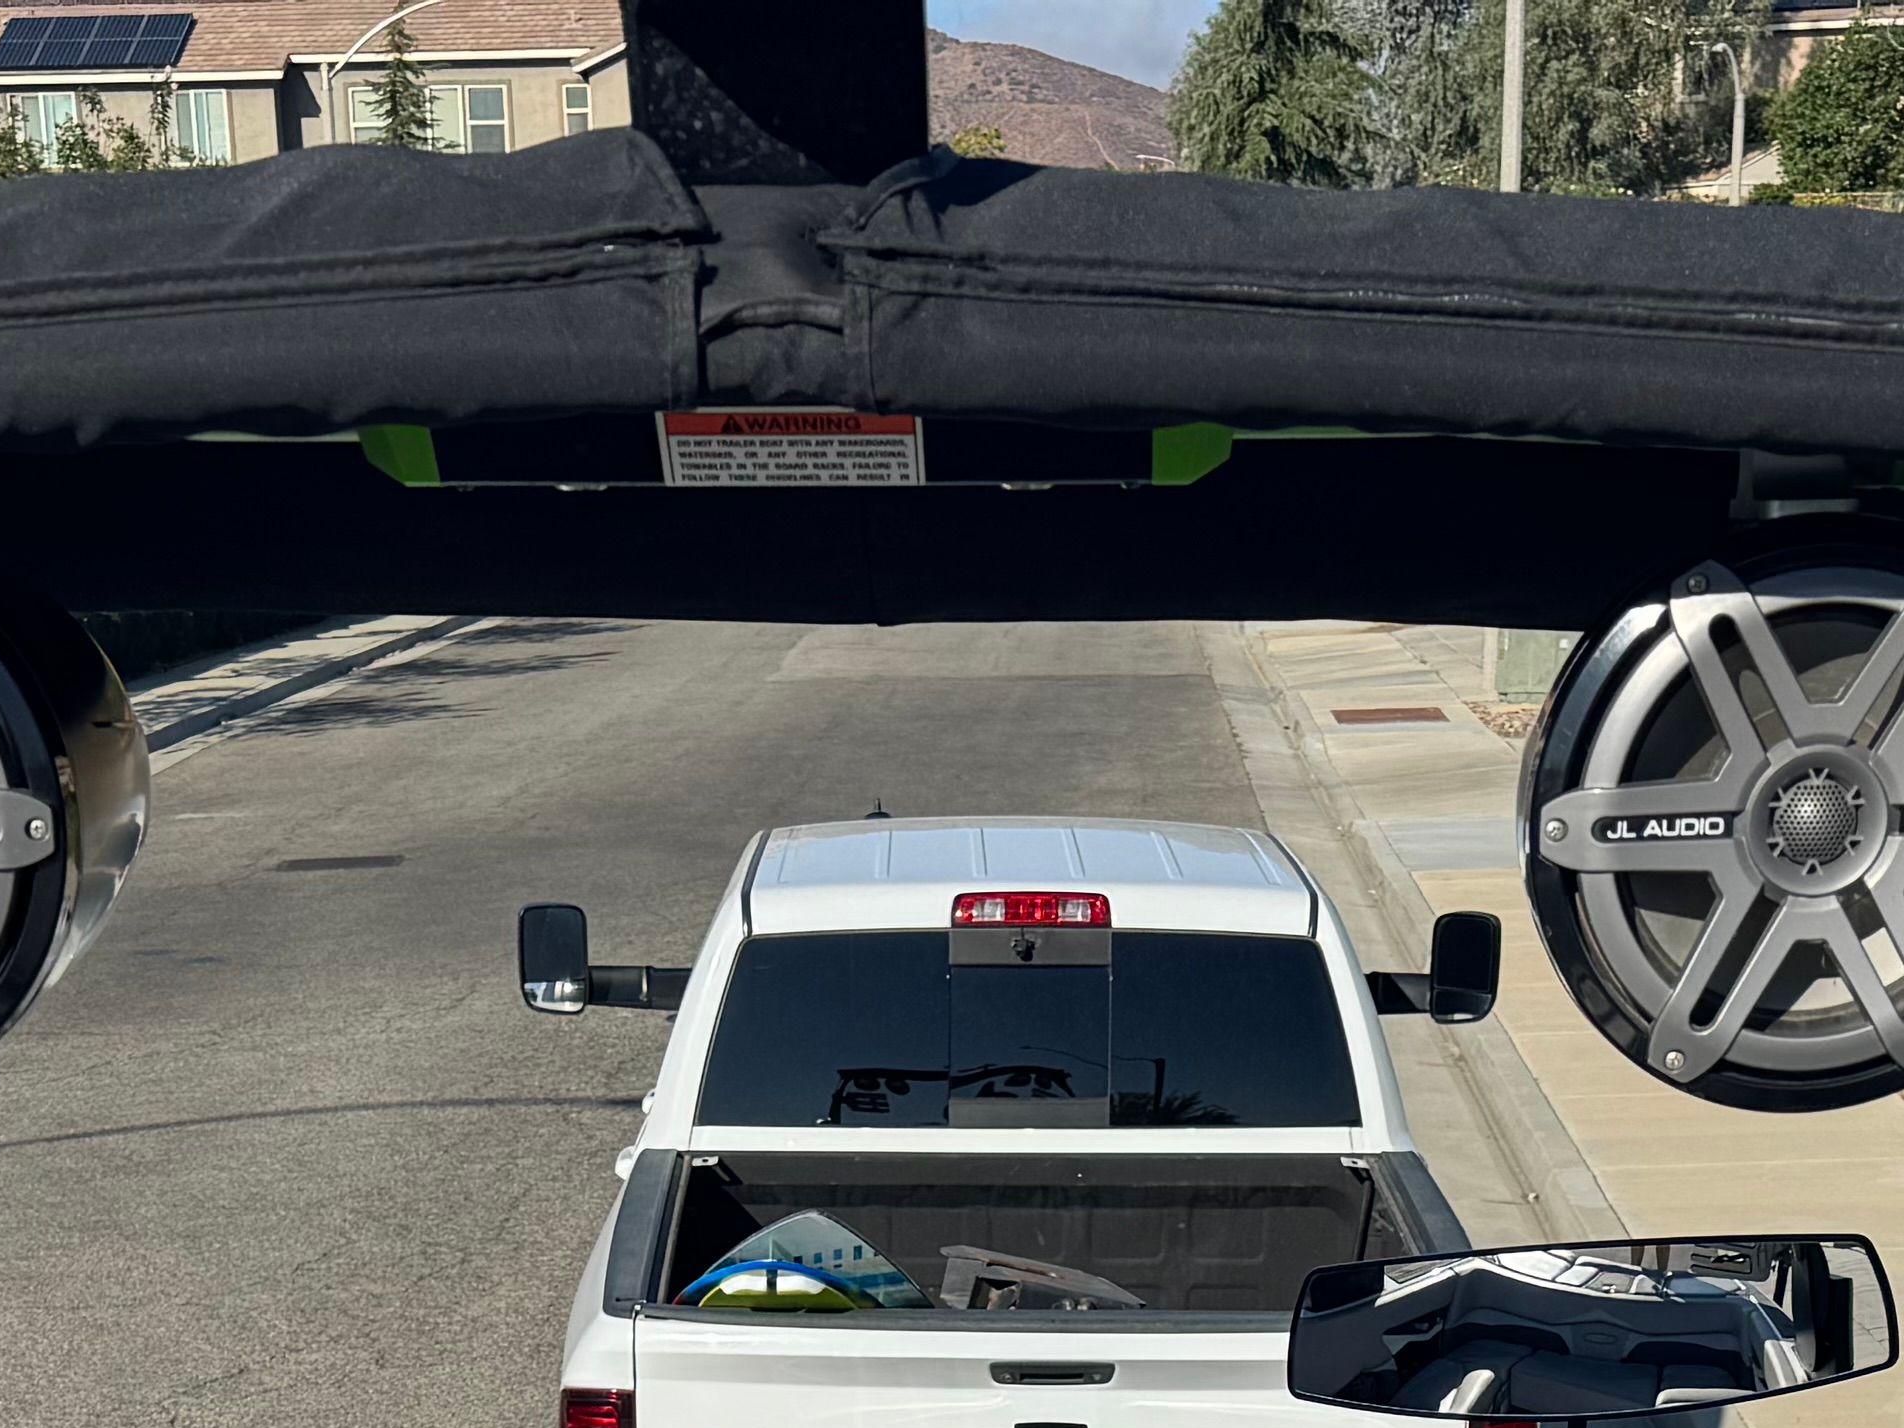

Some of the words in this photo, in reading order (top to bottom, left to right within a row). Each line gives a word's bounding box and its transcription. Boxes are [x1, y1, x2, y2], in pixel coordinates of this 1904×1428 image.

[744, 415, 862, 431] WARNING
[676, 439, 691, 448] DO
[693, 439, 713, 448] NOT
[716, 439, 757, 448] TRAILER
[759, 439, 784, 448] BOAT
[787, 439, 812, 448] WITH
[814, 439, 834, 447] ANY
[744, 451, 758, 459] OR
[767, 451, 787, 459] ANY
[796, 451, 828, 459] OTHER
[836, 450, 907, 459] RECREATIONAL
[736, 462, 747, 470] IN
[751, 462, 769, 470] THE
[774, 462, 808, 470] BOARD
[852, 462, 892, 470] FAILURE
[896, 462, 909, 470] TO
[681, 473, 720, 482] FOLLOW
[1606, 820, 1637, 839] JL
[1643, 817, 1725, 837] AUDIO
